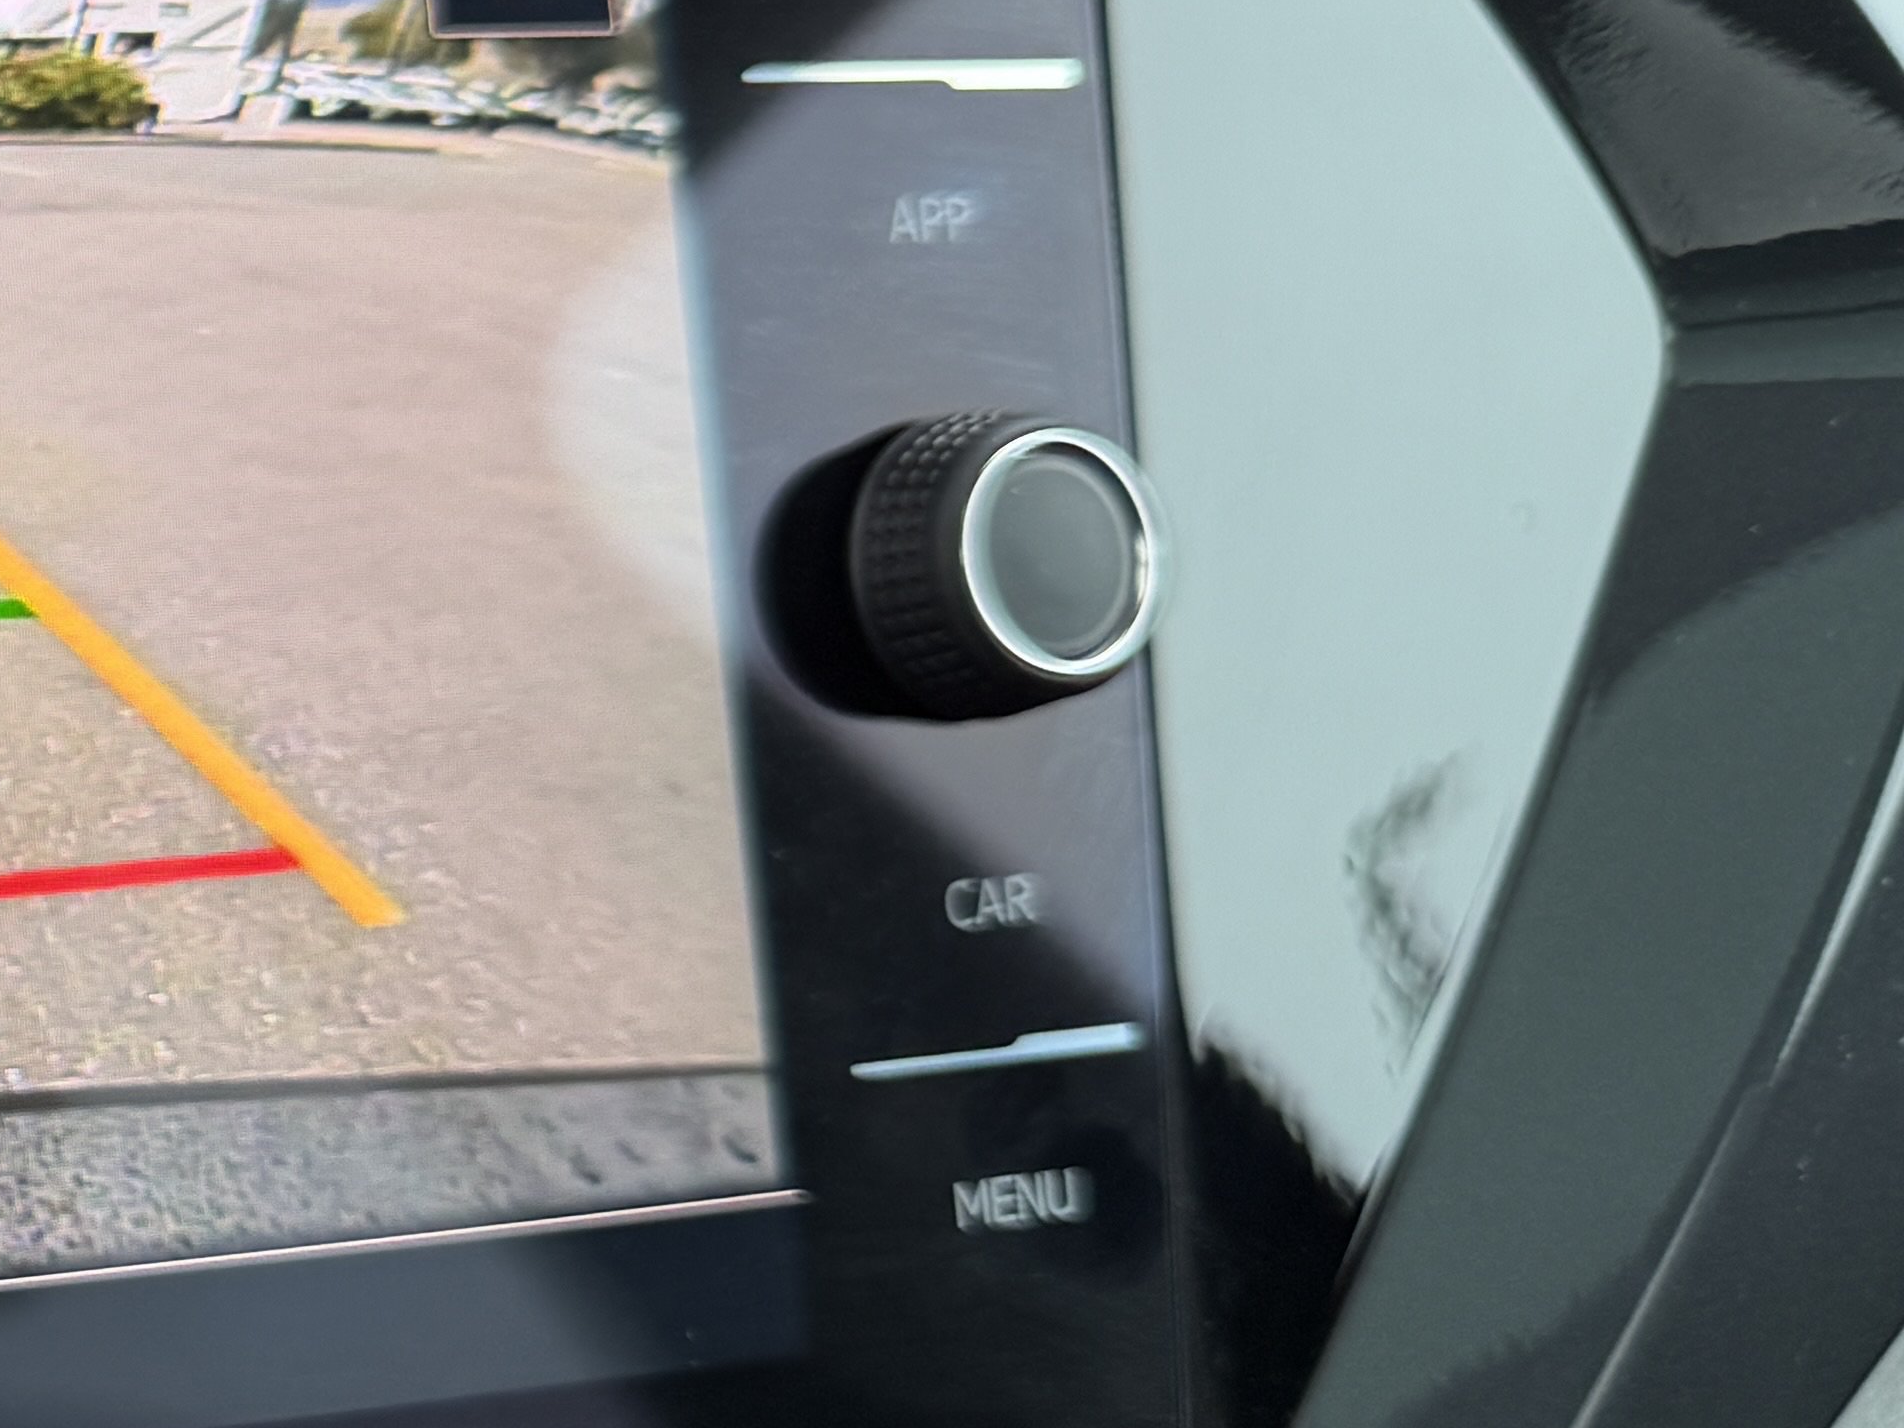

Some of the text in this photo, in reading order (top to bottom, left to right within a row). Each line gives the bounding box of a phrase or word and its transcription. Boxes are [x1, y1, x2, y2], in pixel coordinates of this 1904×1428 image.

[889, 193, 977, 244] APP
[944, 872, 1040, 932] CAR
[952, 1166, 1091, 1233] MENU
